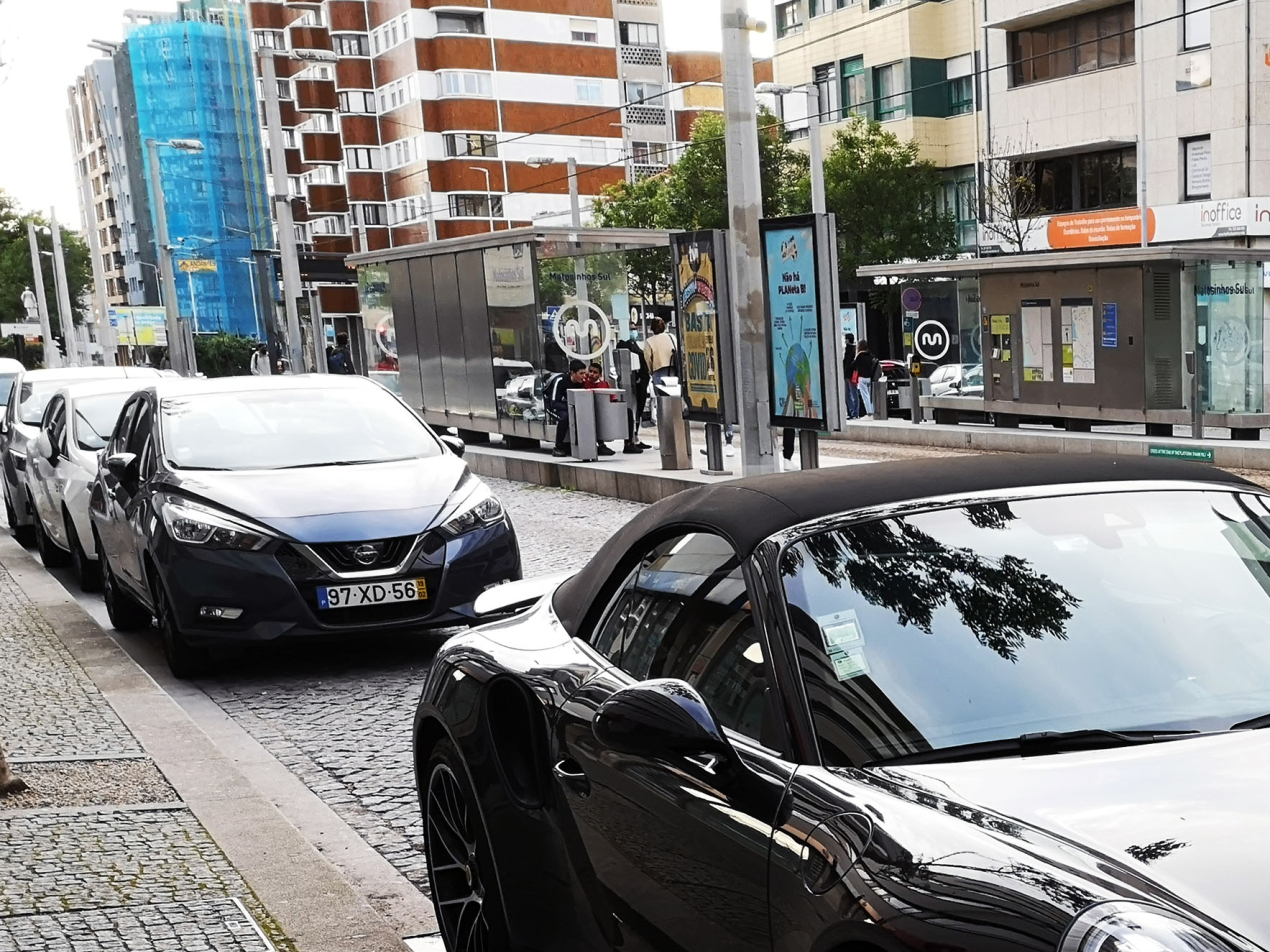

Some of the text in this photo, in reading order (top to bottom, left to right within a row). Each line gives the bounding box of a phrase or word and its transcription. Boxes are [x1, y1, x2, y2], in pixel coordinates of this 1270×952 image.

[1201, 202, 1242, 222] inoffice
[597, 272, 612, 281] Sul
[781, 270, 801, 282] Não há
